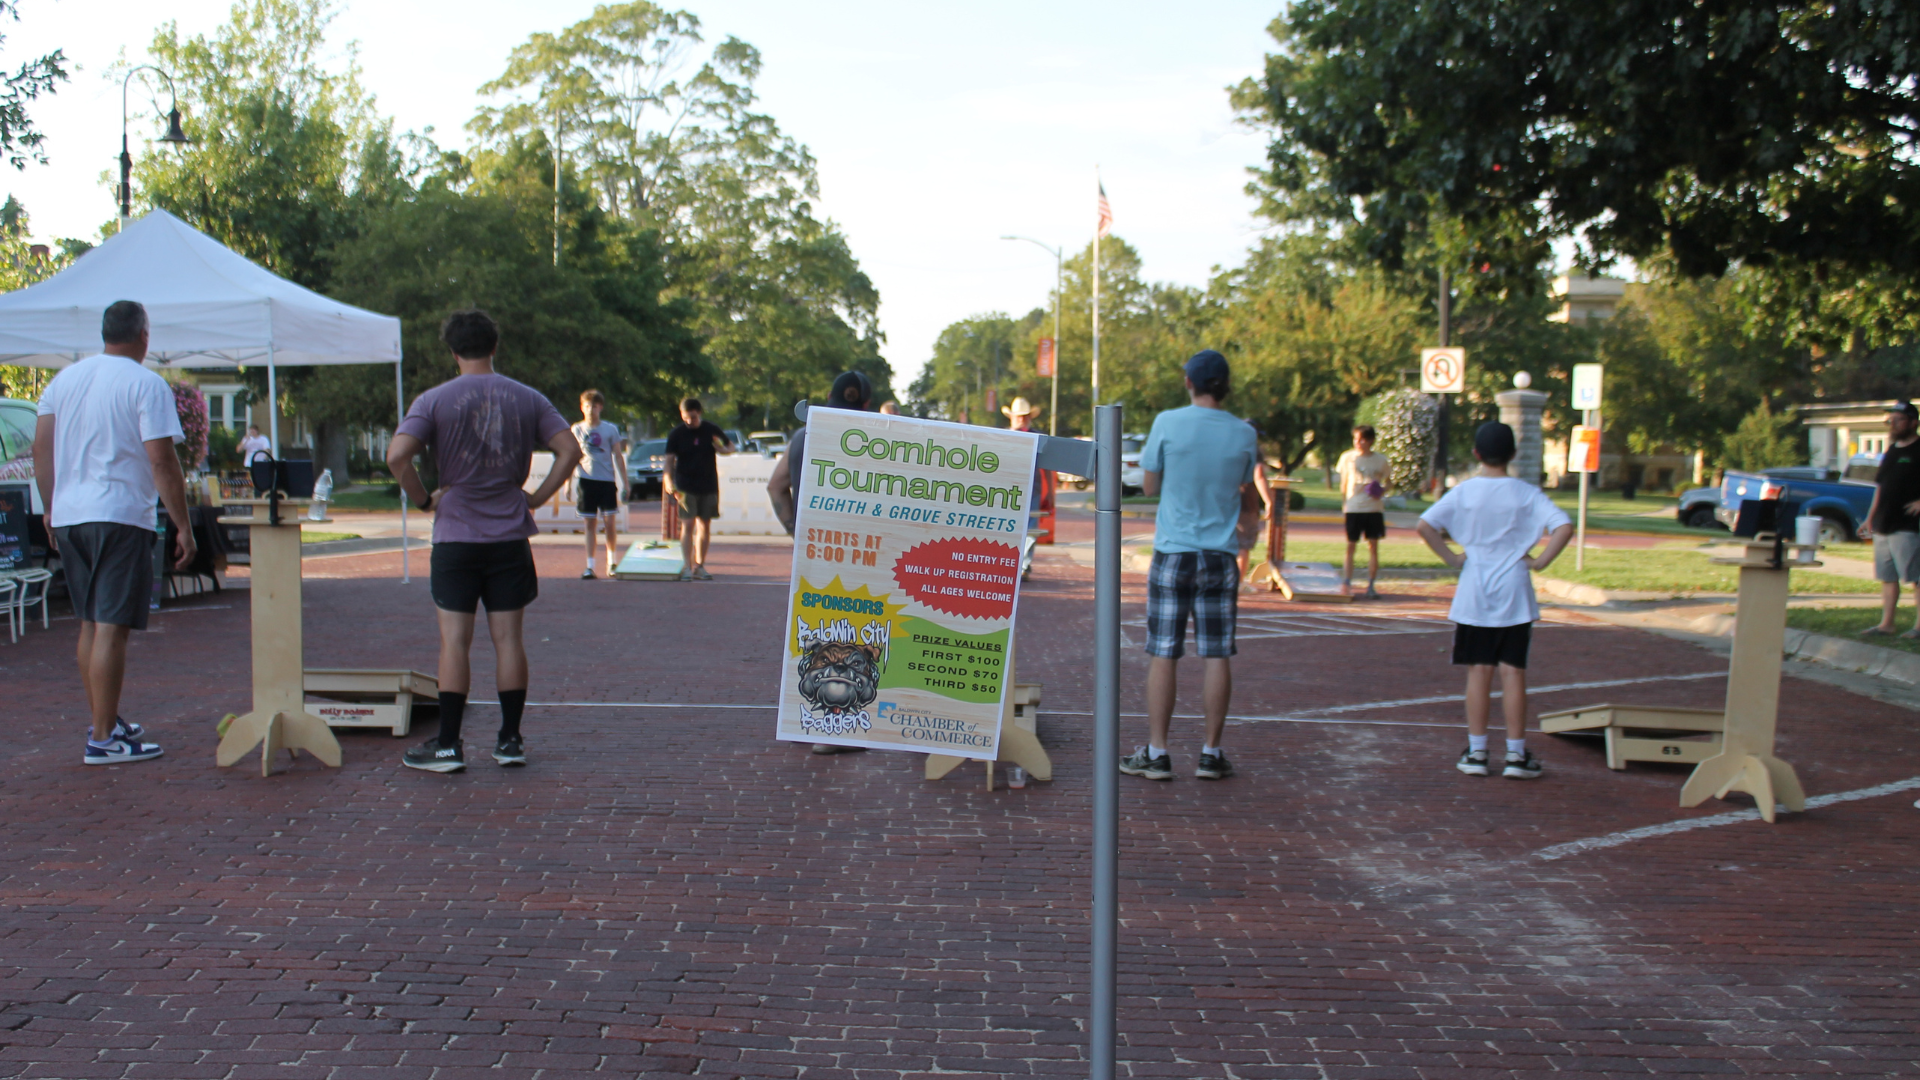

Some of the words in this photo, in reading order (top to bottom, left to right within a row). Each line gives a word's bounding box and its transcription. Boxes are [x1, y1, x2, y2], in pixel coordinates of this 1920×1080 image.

[840, 428, 999, 474] Cornhole
[810, 458, 1022, 511] Tournament
[809, 495, 867, 515] EIGHTH
[871, 503, 883, 517] &
[889, 505, 942, 524] GROVE
[945, 512, 1016, 532] STREETS
[807, 527, 859, 548] STARTS
[865, 534, 882, 550] AT
[806, 543, 845, 563] 6:00
[852, 549, 877, 567] PM
[951, 552, 964, 562] NO
[967, 553, 997, 565] ENTRY
[1000, 557, 1016, 568] FEE
[905, 564, 930, 575] WALK
[933, 568, 945, 577] UP
[948, 569, 1014, 585] REGISTRATION
[921, 584, 937, 594] ALL
[940, 586, 964, 597] AGES
[967, 589, 1011, 602] WELCOME
[801, 592, 884, 616] SPONSORS
[913, 634, 950, 645] PRIZE
[954, 639, 1002, 651] VALUES
[922, 649, 962, 662] FIRST
[967, 655, 1000, 667] $100
[907, 662, 968, 676] SECOND
[973, 670, 998, 680] $70
[924, 677, 966, 690] THIRD
[971, 683, 996, 694] $50
[890, 712, 966, 732] CHAMBER
[967, 722, 979, 734] of
[901, 726, 992, 748] COMMERCE
[435, 748, 456, 759] HOKA
